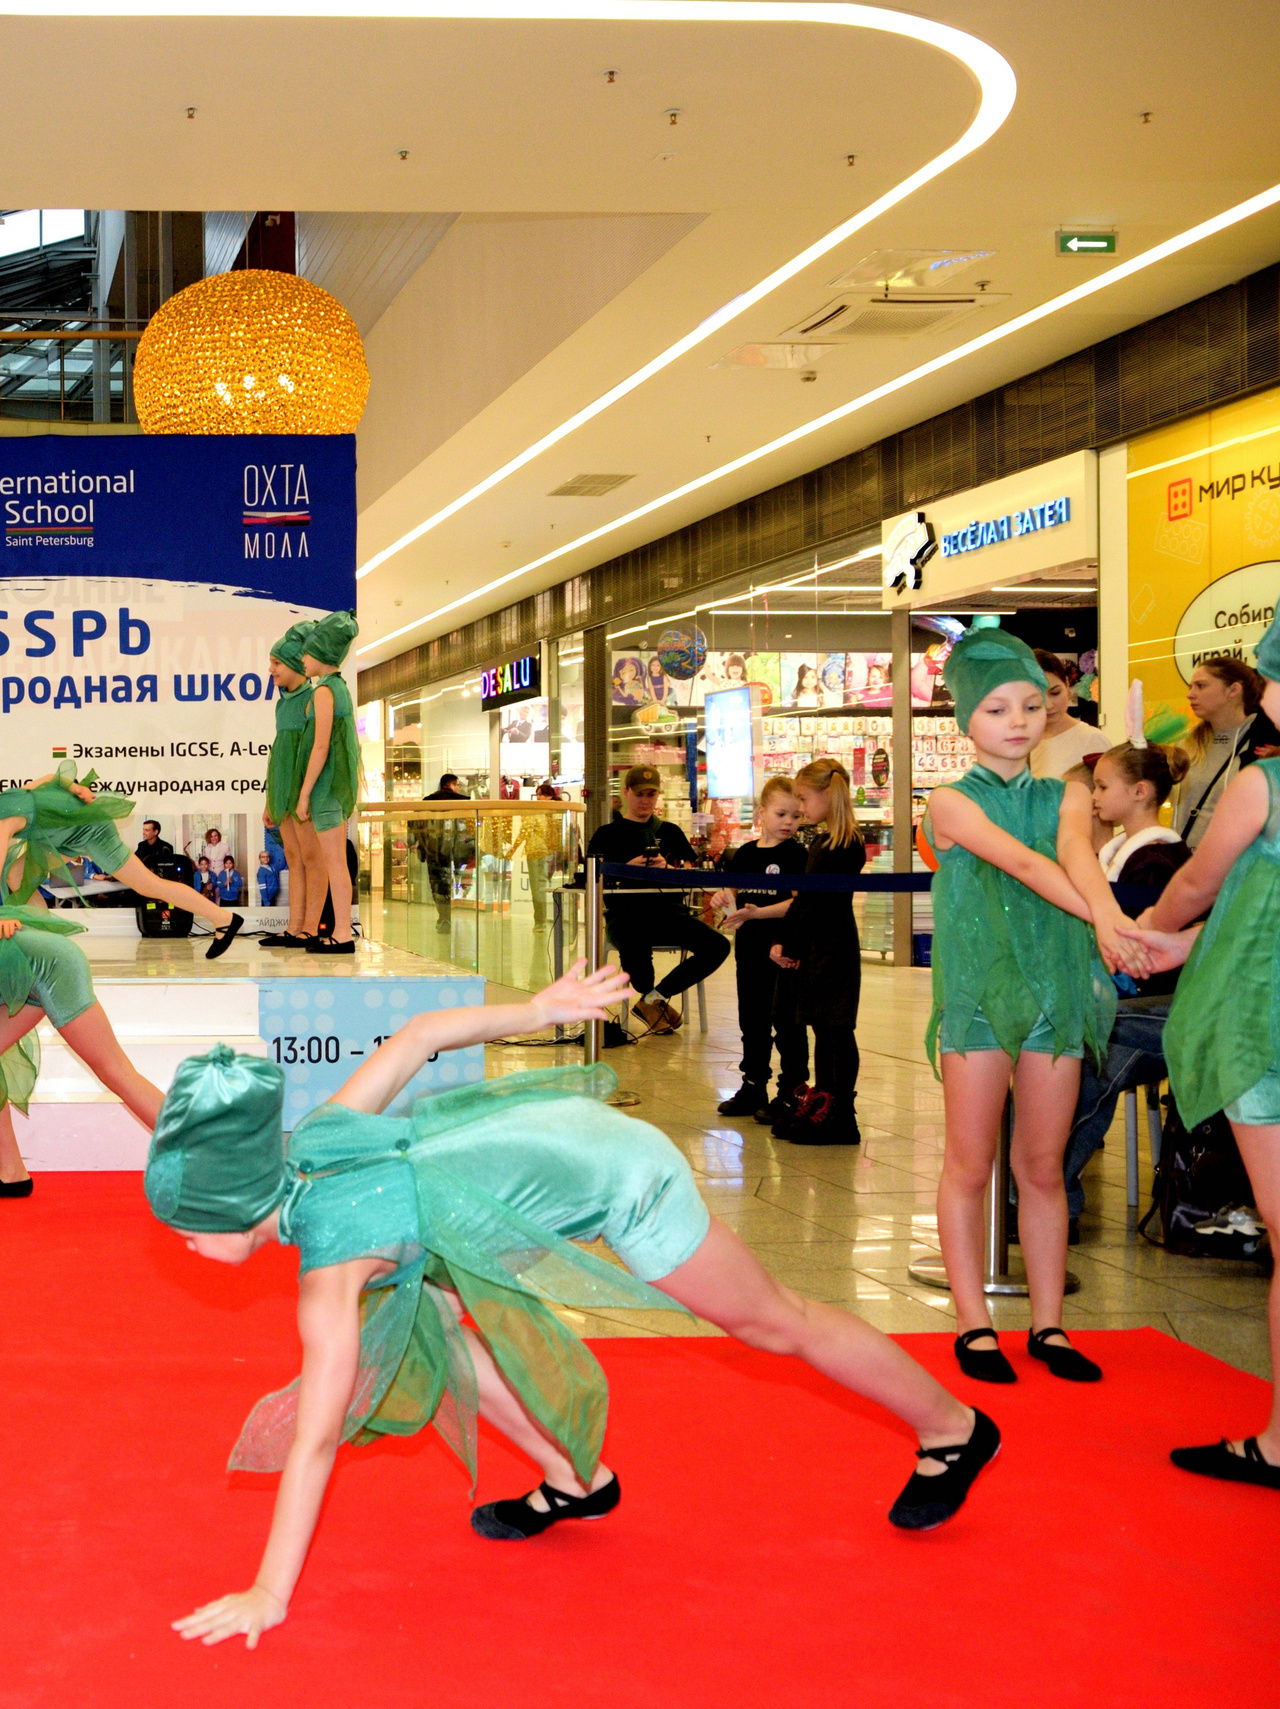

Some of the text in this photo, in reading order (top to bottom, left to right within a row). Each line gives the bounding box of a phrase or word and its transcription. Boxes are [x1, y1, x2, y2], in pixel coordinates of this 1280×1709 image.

[244, 464, 310, 507] ОХТА
[5, 499, 94, 524] School
[940, 515, 1011, 558] ВЕСЁЛАЯ
[1012, 496, 1071, 538] ЗАТЕЯ
[5, 535, 94, 548] Saint Petersburg
[244, 531, 309, 559] МОЛЛ
[481, 655, 530, 700] DESALU
[73, 743, 165, 759] Экзамены
[170, 741, 224, 758] IGCSE,
[74, 779, 225, 796] еждународная
[272, 1035, 340, 1065] 13:00
